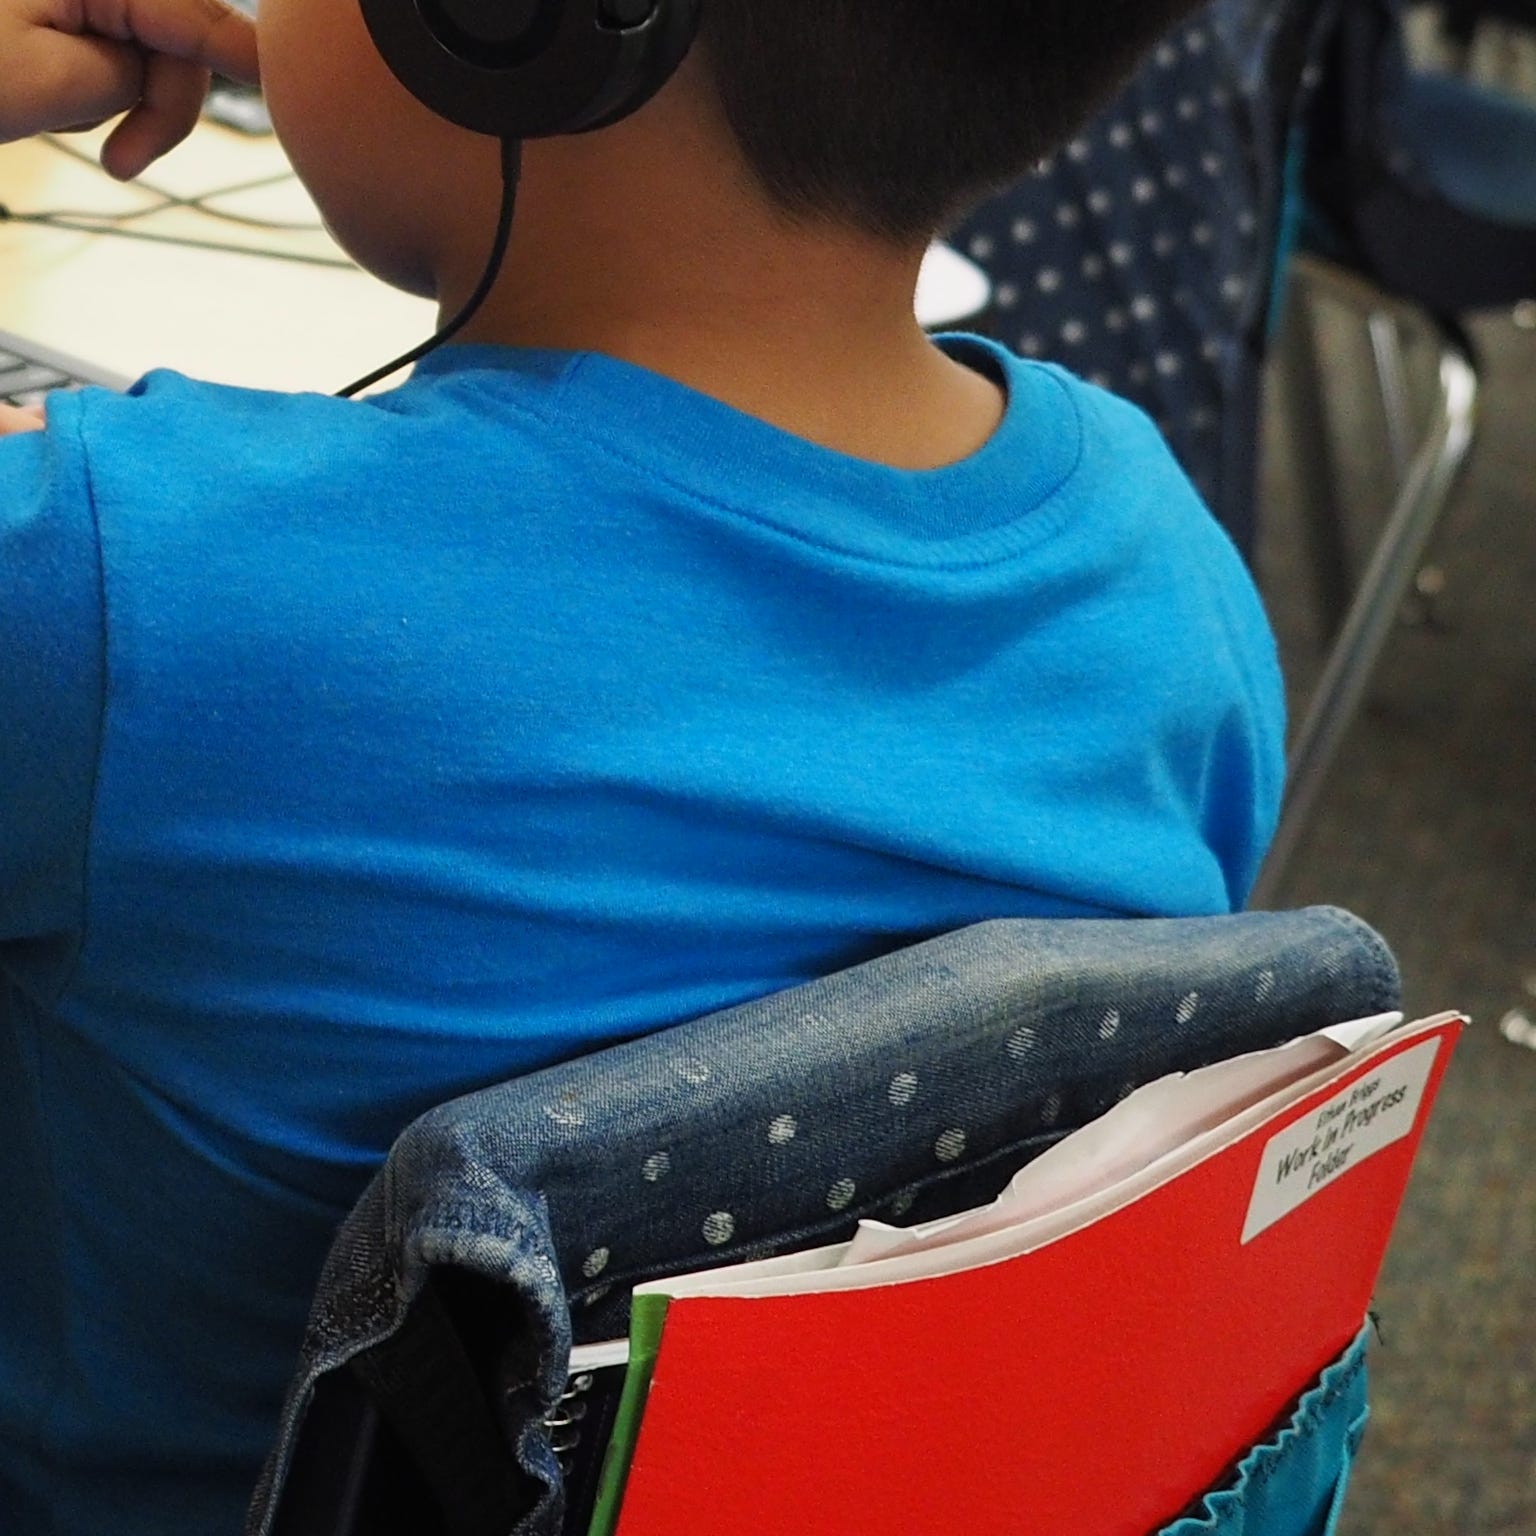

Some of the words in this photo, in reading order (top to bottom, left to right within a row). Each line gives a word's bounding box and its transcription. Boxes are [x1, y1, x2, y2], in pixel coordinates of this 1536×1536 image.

[1276, 1134, 1322, 1185] Work
[1340, 1084, 1408, 1138] Progress
[1307, 1143, 1354, 1190] Folder
